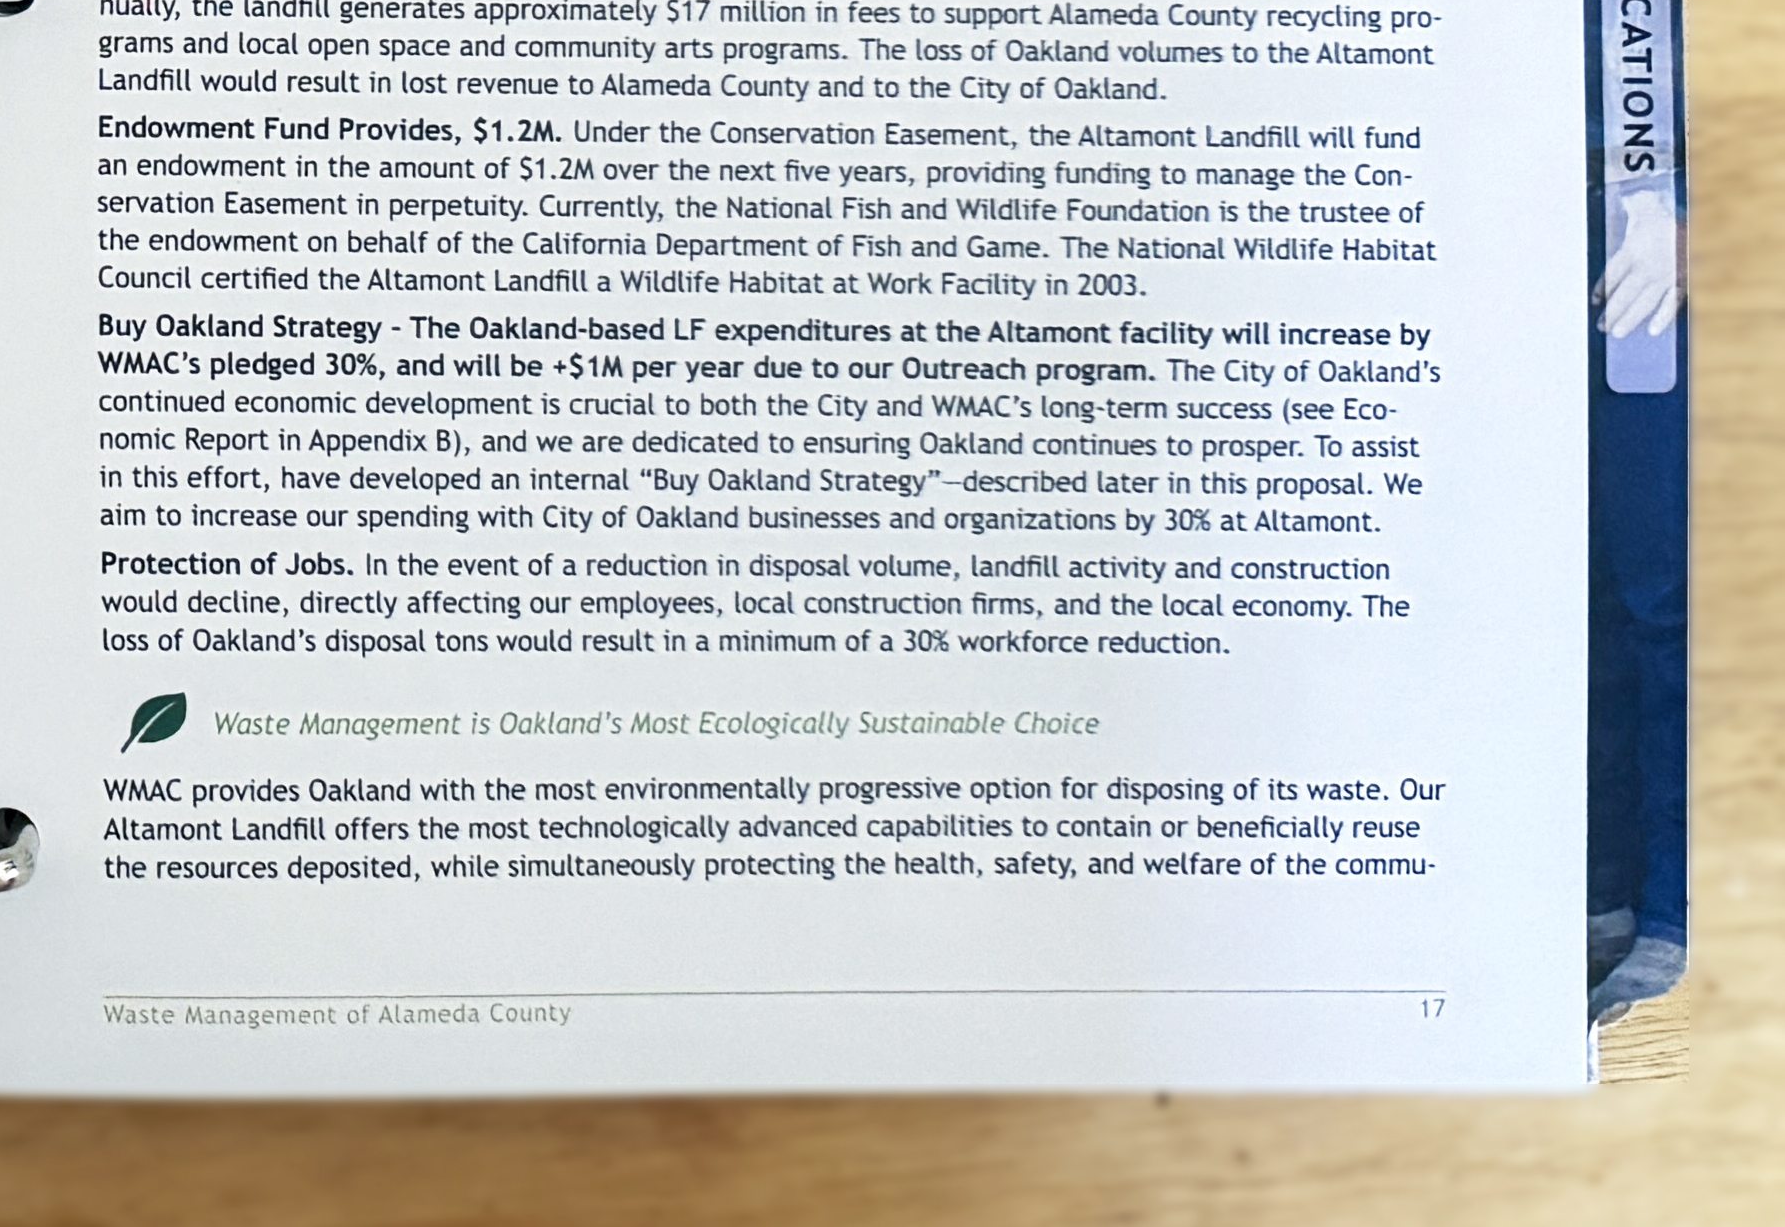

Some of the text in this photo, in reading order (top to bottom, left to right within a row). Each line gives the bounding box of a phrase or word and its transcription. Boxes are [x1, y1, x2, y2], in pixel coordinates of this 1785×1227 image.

[97, 264, 1148, 302] Council certified the Altamont Landfill a Wildlife Habitat at Work Facility in 2003.
[214, 710, 1101, 742] Waste Management is Oakland’s Most Ecologically Sustainable Choice
[103, 850, 1436, 886] the resources deposited, while simultaneously protecting the health, safety, and welfare of the commu-
[103, 1002, 572, 1030] Waste Management of Alameda County
[1421, 998, 1446, 1019] 17
